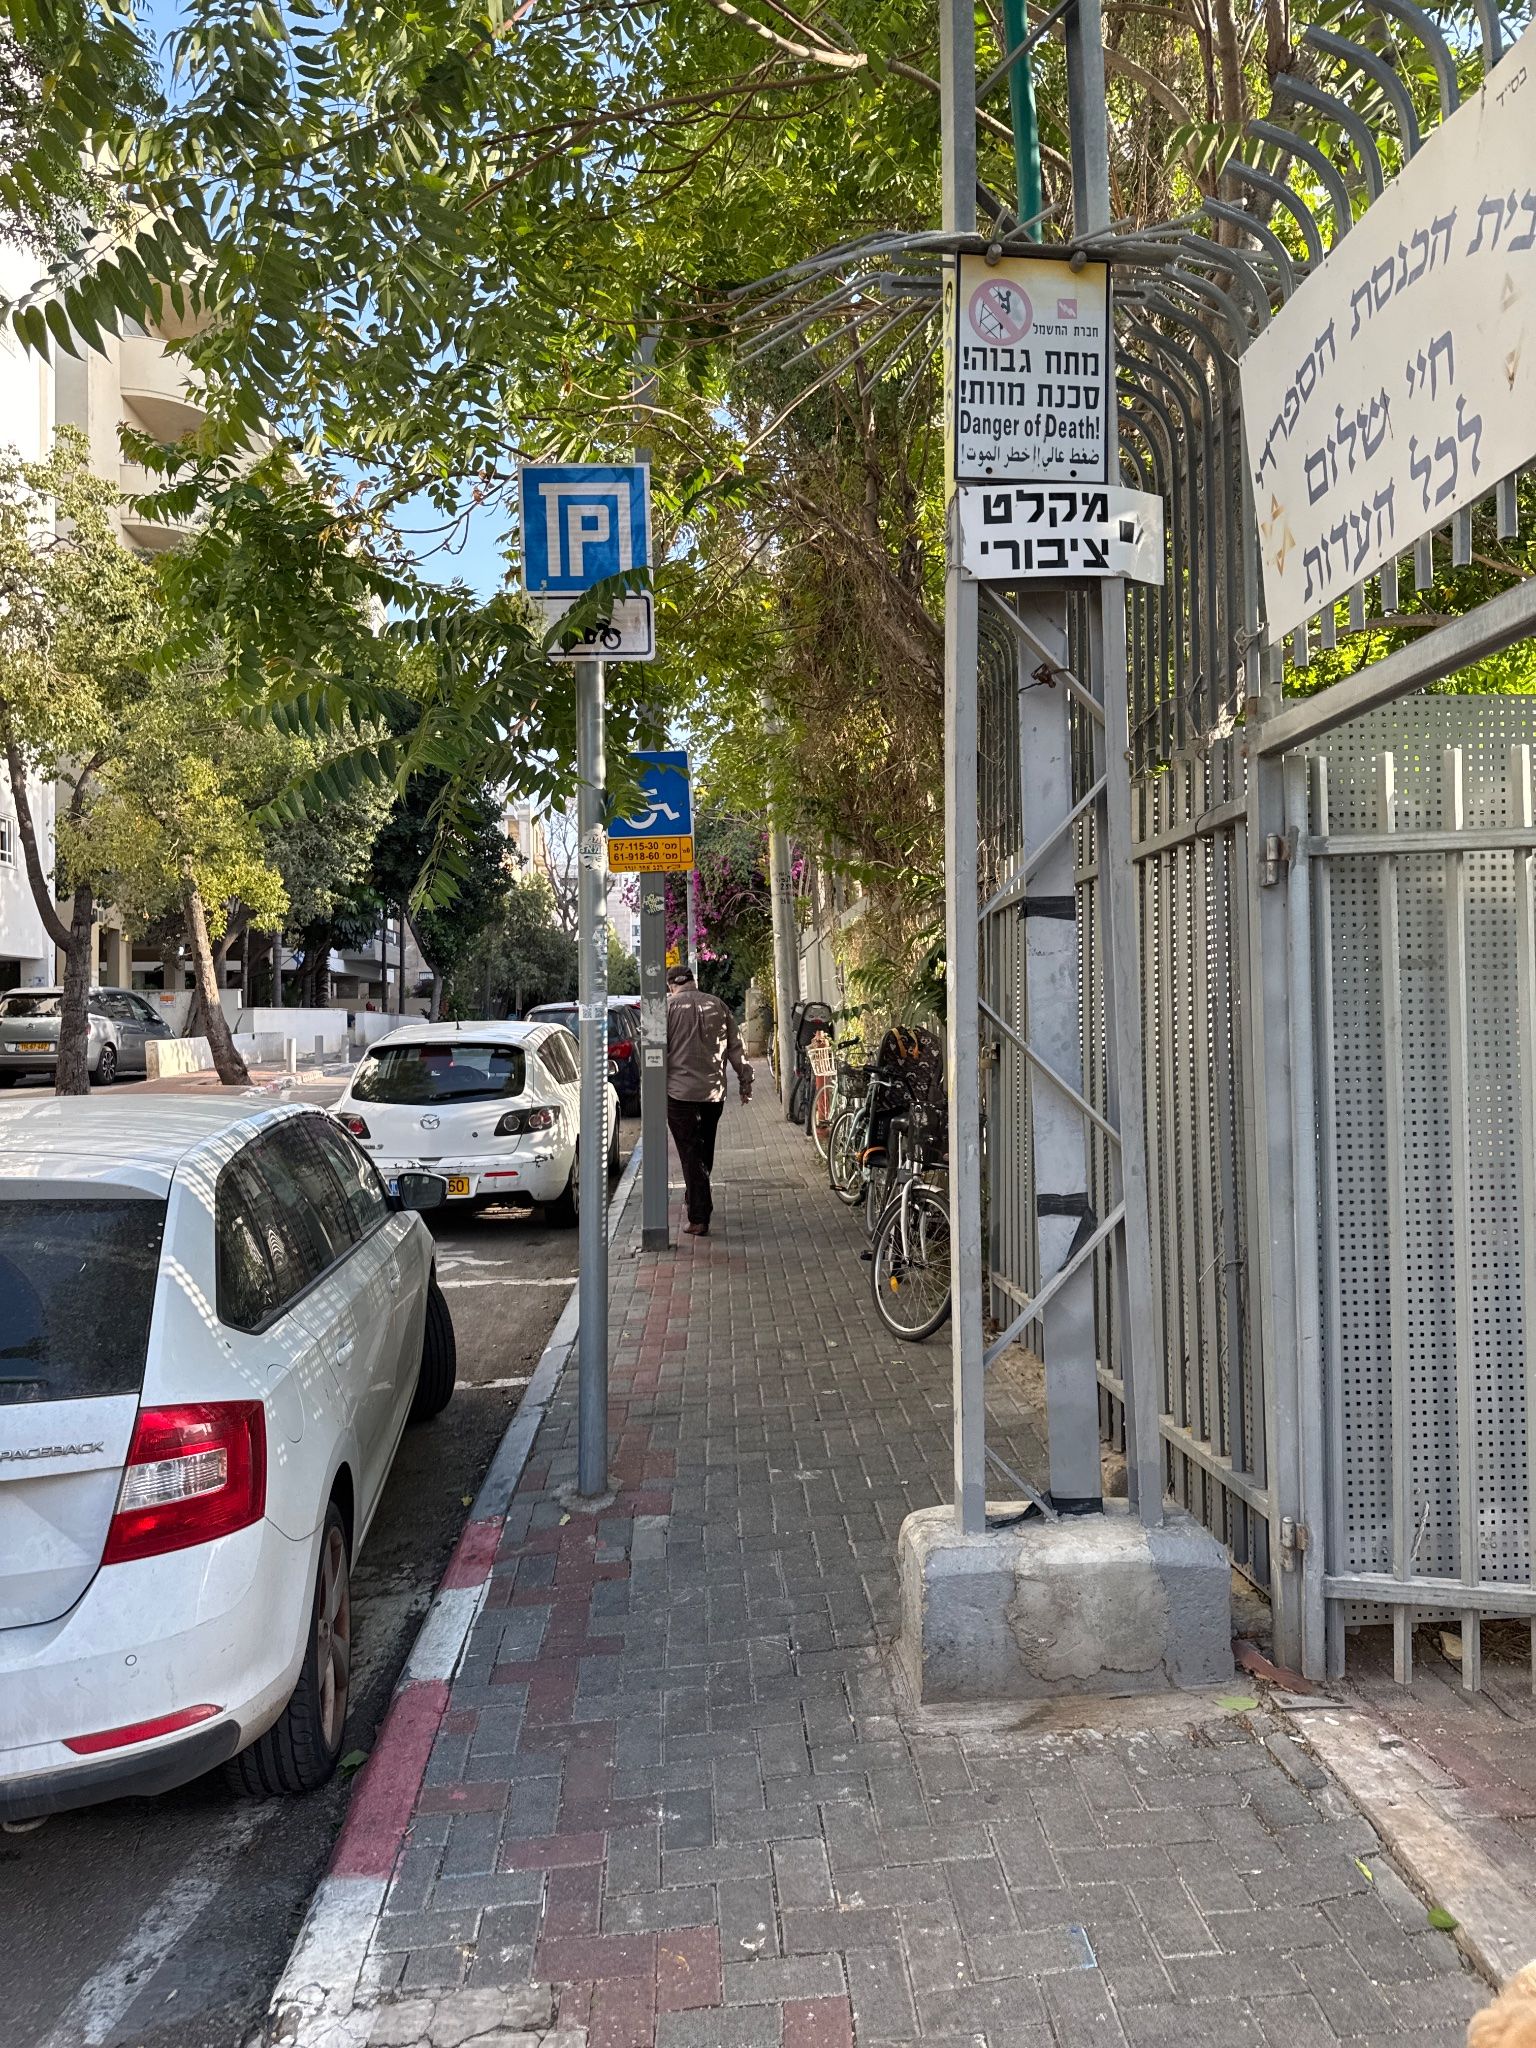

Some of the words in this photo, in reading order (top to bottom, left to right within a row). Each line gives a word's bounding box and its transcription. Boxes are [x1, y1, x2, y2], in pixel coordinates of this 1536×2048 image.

[1466, 188, 1536, 256] בית
[1350, 205, 1458, 341] הכנסת
[1033, 322, 1068, 336] החשמל
[1073, 326, 1099, 338] חברת
[963, 346, 1032, 374] גבוה!
[1044, 350, 1099, 377] מתח
[1406, 330, 1455, 402] חיי
[960, 379, 1025, 407] מוות!
[1037, 383, 1101, 410] סכנת
[1255, 317, 1336, 490] הספרדי
[960, 409, 1020, 441] Danger
[1024, 413, 1042, 437] of
[1044, 413, 1100, 441] Death!
[1069, 446, 1100, 465] ضغط
[1304, 387, 1391, 506] שלום
[1409, 393, 1483, 514] לכל
[983, 489, 1109, 528] מקלט
[567, 504, 609, 577] P
[980, 538, 1110, 570] ציבורי
[1303, 476, 1396, 604] העדות
[613, 841, 659, 852] 57-115-30
[613, 851, 660, 861] 61-918-60
